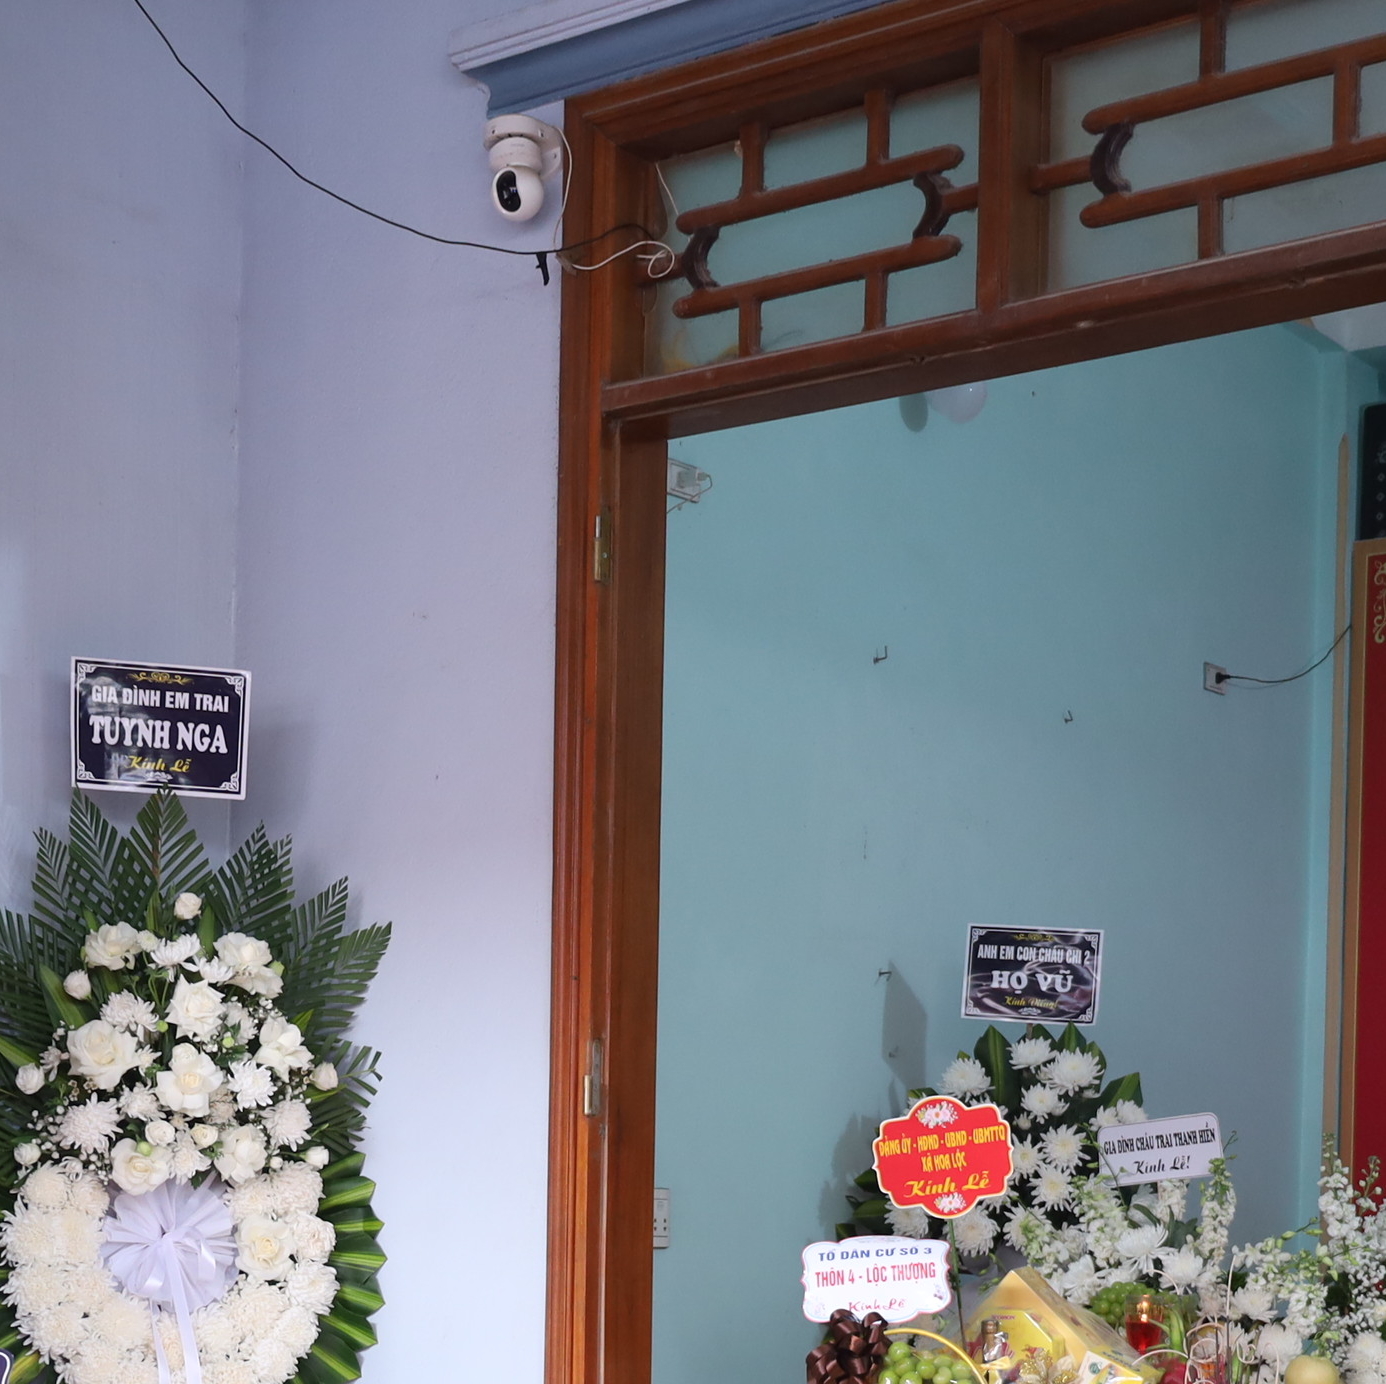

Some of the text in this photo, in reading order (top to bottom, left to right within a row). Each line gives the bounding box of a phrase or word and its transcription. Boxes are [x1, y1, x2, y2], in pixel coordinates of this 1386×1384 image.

[91, 685, 229, 713] GIA ĐÌNH EM TRAI
[176, 721, 228, 754] NGA
[125, 755, 193, 773] Kính Lễ
[977, 944, 997, 960] ANH
[999, 946, 1015, 960] EM
[1016, 946, 1036, 962] CON
[1038, 945, 1064, 963] CHÁU
[1083, 950, 1090, 964] 2
[990, 969, 1074, 994] HỌ VŨ
[878, 1125, 1006, 1158] ĐẢNG ỦY HĐND UBND UBMTTQ
[1104, 1141, 1117, 1155] GIA
[1117, 1135, 1135, 1154] ĐÌNH
[1136, 1132, 1154, 1151] CHÁU
[1155, 1133, 1172, 1149] TRAI
[1173, 1130, 1198, 1147] THANH
[921, 1148, 967, 1173] XÃ HOA LỘC
[1134, 1159, 1165, 1174] Kính
[903, 1170, 990, 1198] Kính Lễ
[840, 1248, 870, 1261] DÂN
[875, 1247, 896, 1257] CƯ
[923, 1247, 932, 1255] 3
[815, 1262, 936, 1288] THÔN 4 LỘC THƯỢNG
